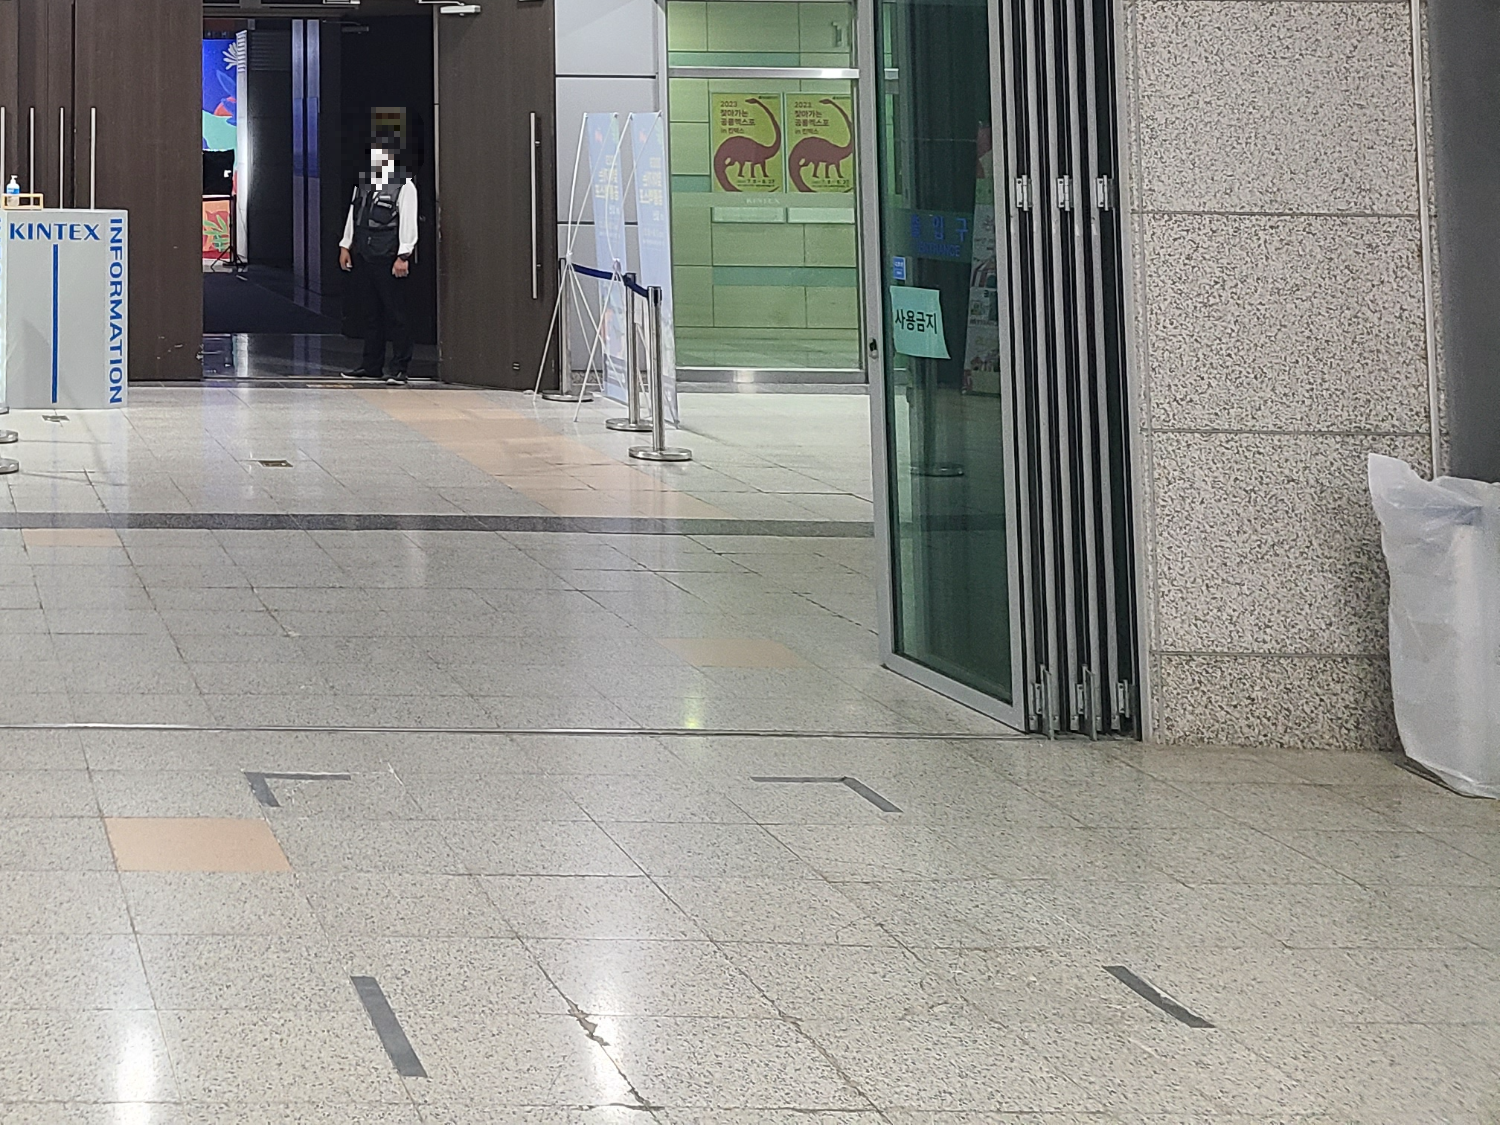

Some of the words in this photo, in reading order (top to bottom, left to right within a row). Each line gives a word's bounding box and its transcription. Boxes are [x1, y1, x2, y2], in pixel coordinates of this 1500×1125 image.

[9, 222, 101, 241] KINTEX
[109, 218, 123, 404] INFORMATION
[894, 308, 938, 335] 사용금지
